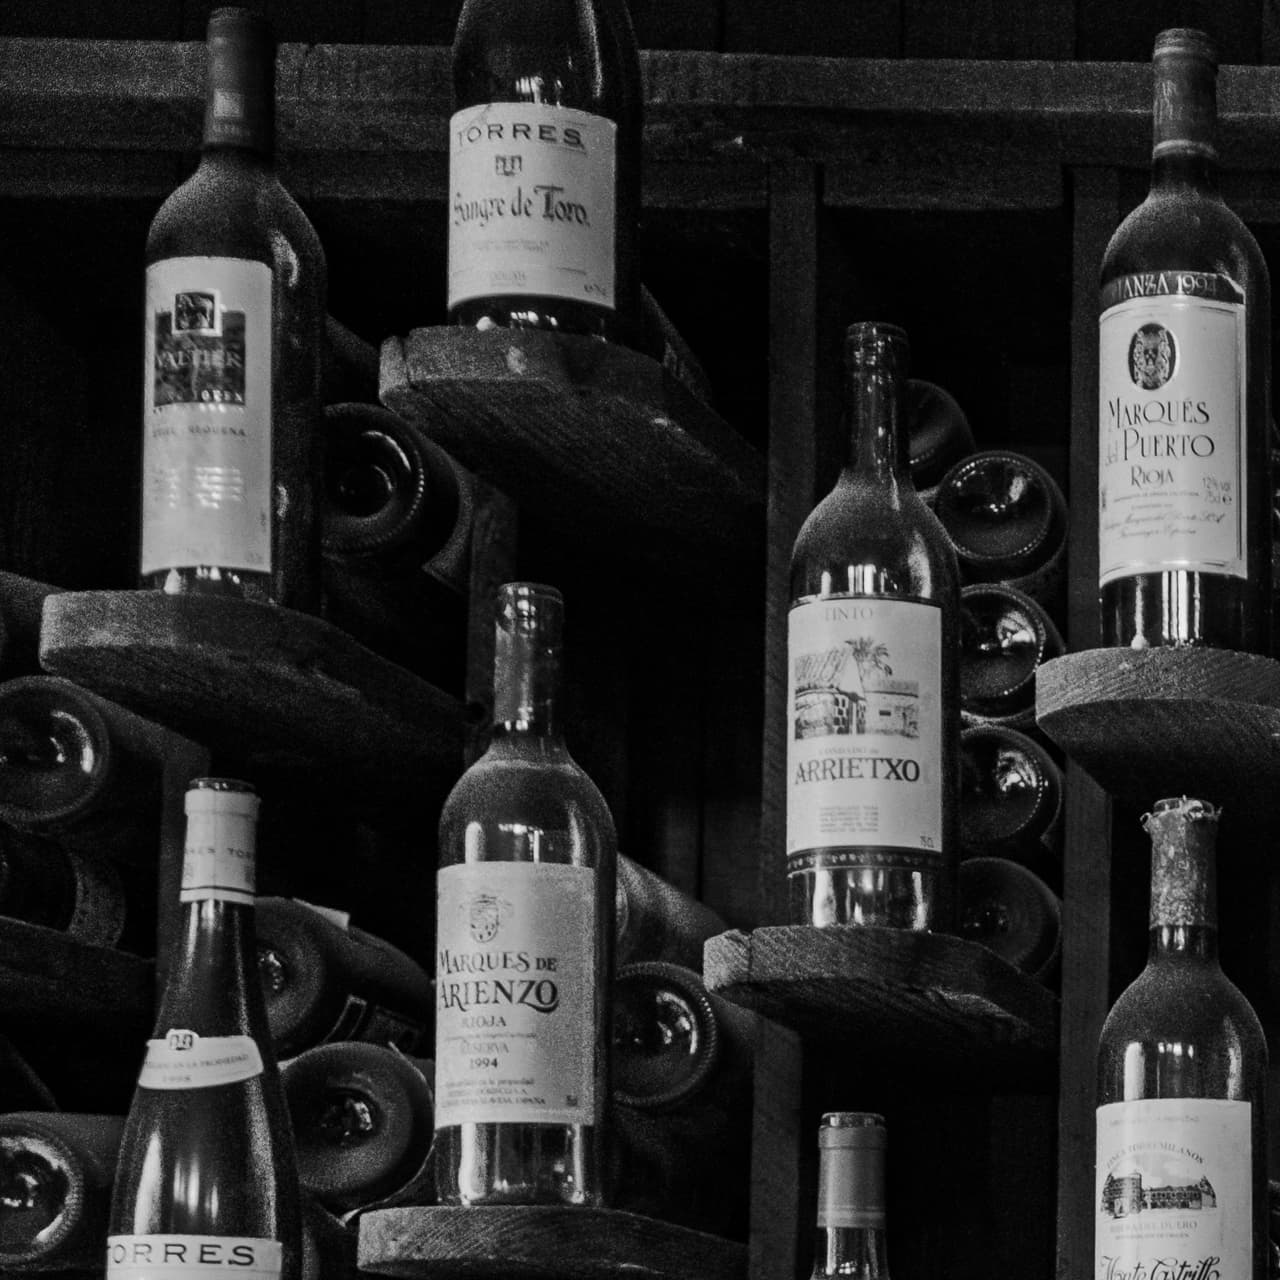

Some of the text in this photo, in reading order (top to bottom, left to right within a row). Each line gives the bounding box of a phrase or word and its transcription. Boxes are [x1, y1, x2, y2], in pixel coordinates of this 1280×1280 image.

[457, 123, 584, 149] TORRES
[511, 187, 533, 217] de
[824, 606, 874, 623] TINTO
[794, 756, 921, 785] ARRIETXO
[535, 957, 558, 973] DE
[470, 1058, 498, 1069] 1994
[108, 1243, 257, 1267] ORRES
